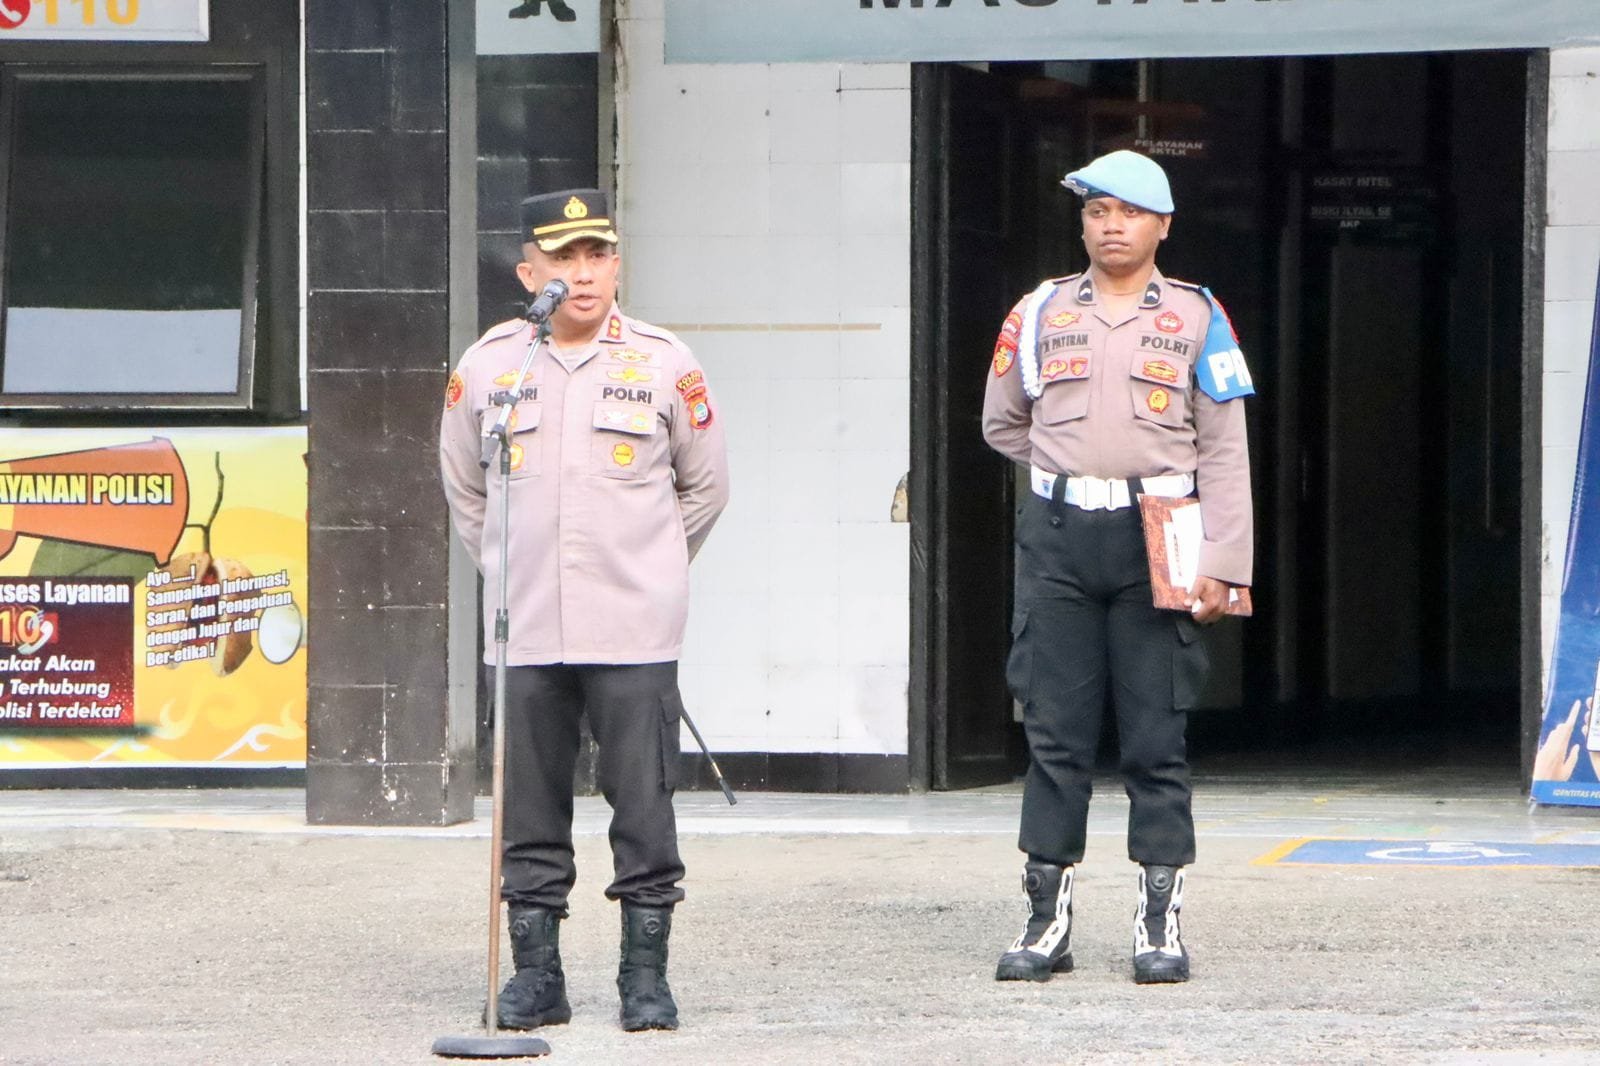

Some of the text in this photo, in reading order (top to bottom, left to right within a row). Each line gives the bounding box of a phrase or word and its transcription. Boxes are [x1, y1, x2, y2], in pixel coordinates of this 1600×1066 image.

[33, 0, 139, 26] 110
[1134, 139, 1203, 149] PELAYANAN
[1140, 335, 1190, 356] POLRI
[602, 386, 652, 405] POLRI
[91, 473, 174, 505] POLISI
[146, 571, 172, 588] Ayo
[146, 569, 290, 608] Sampaikan Informasi,
[44, 580, 130, 605] Layanan
[146, 591, 293, 628] Saran, dan Pengaduan
[146, 616, 260, 648] dengan Jujur dan
[44, 654, 96, 672] Akan
[146, 641, 216, 668] Ber-etika !
[10, 678, 111, 699] Terhubung
[38, 701, 122, 719] Terdekat
